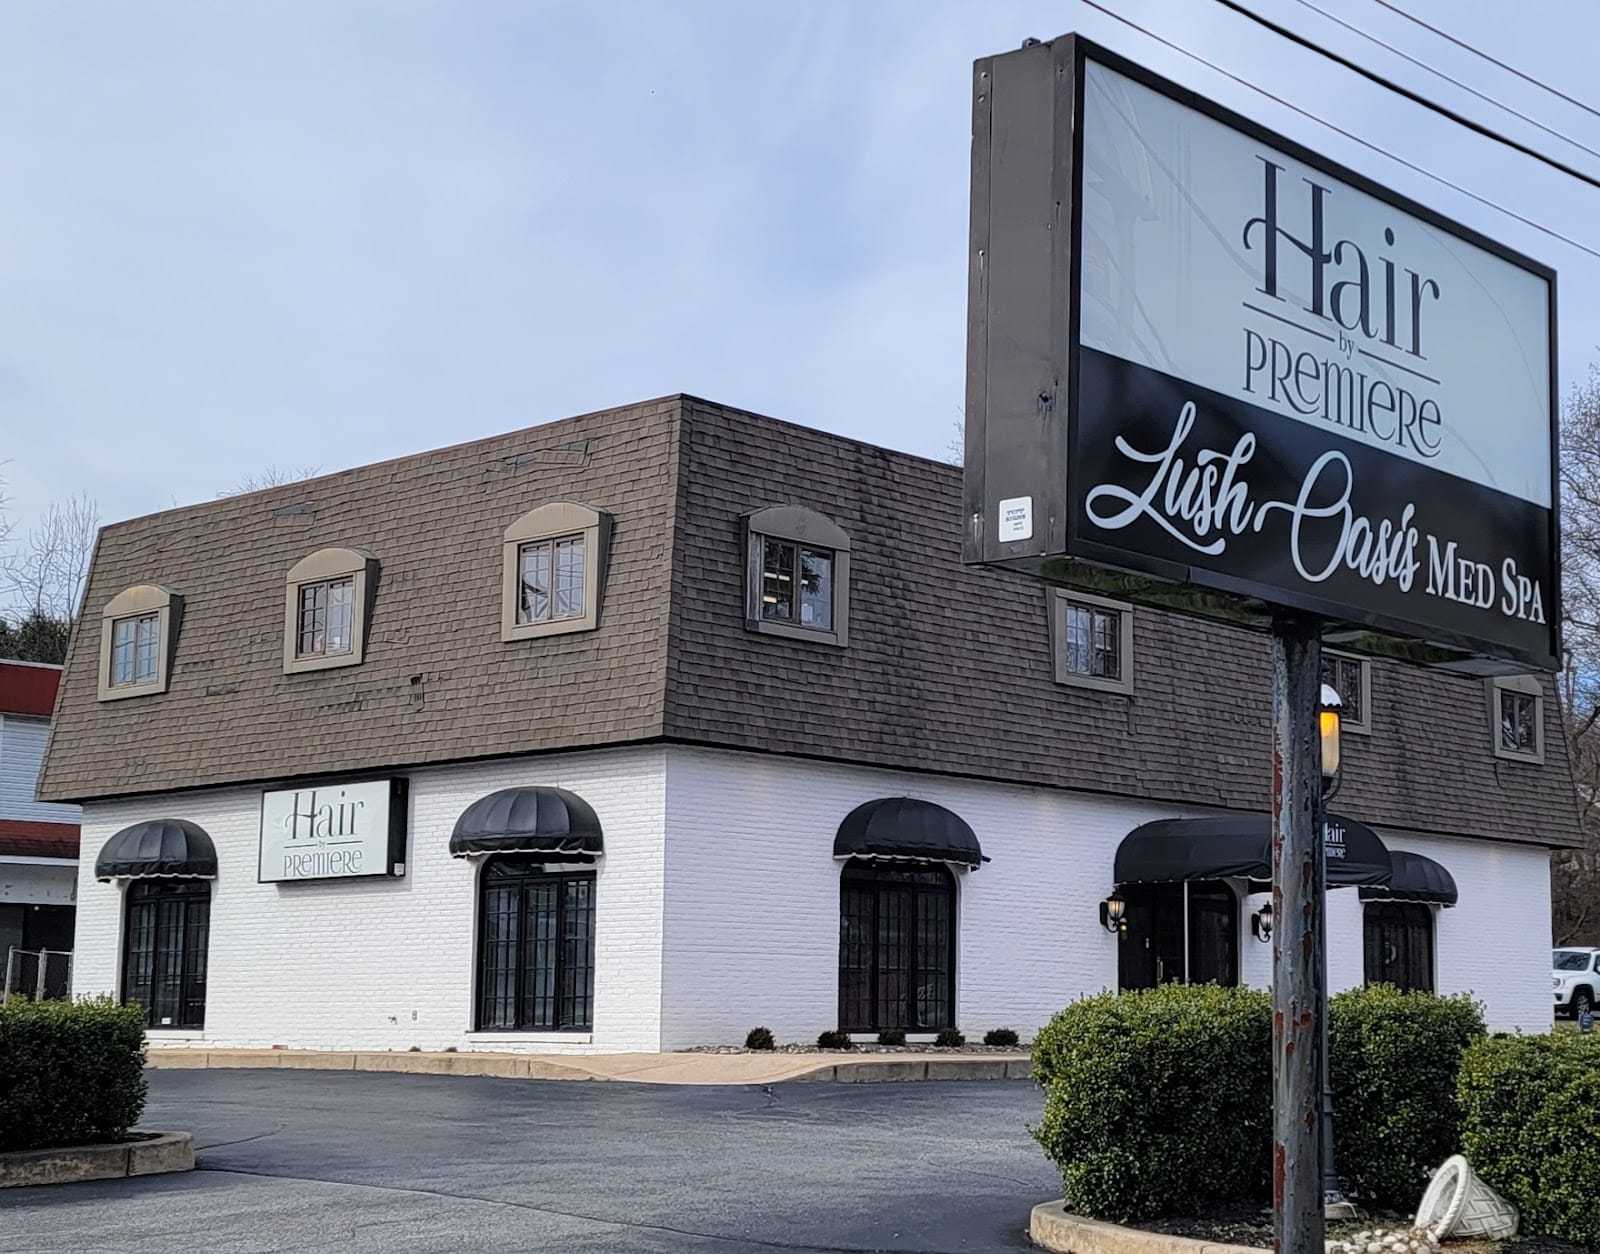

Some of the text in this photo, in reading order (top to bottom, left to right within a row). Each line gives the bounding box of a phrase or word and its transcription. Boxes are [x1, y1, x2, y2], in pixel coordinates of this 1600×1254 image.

[1243, 155, 1441, 360] Hair
[1339, 330, 1355, 360] by
[1086, 401, 1255, 555] Lush
[1253, 450, 1420, 592] Oasis
[284, 791, 364, 839] Hair
